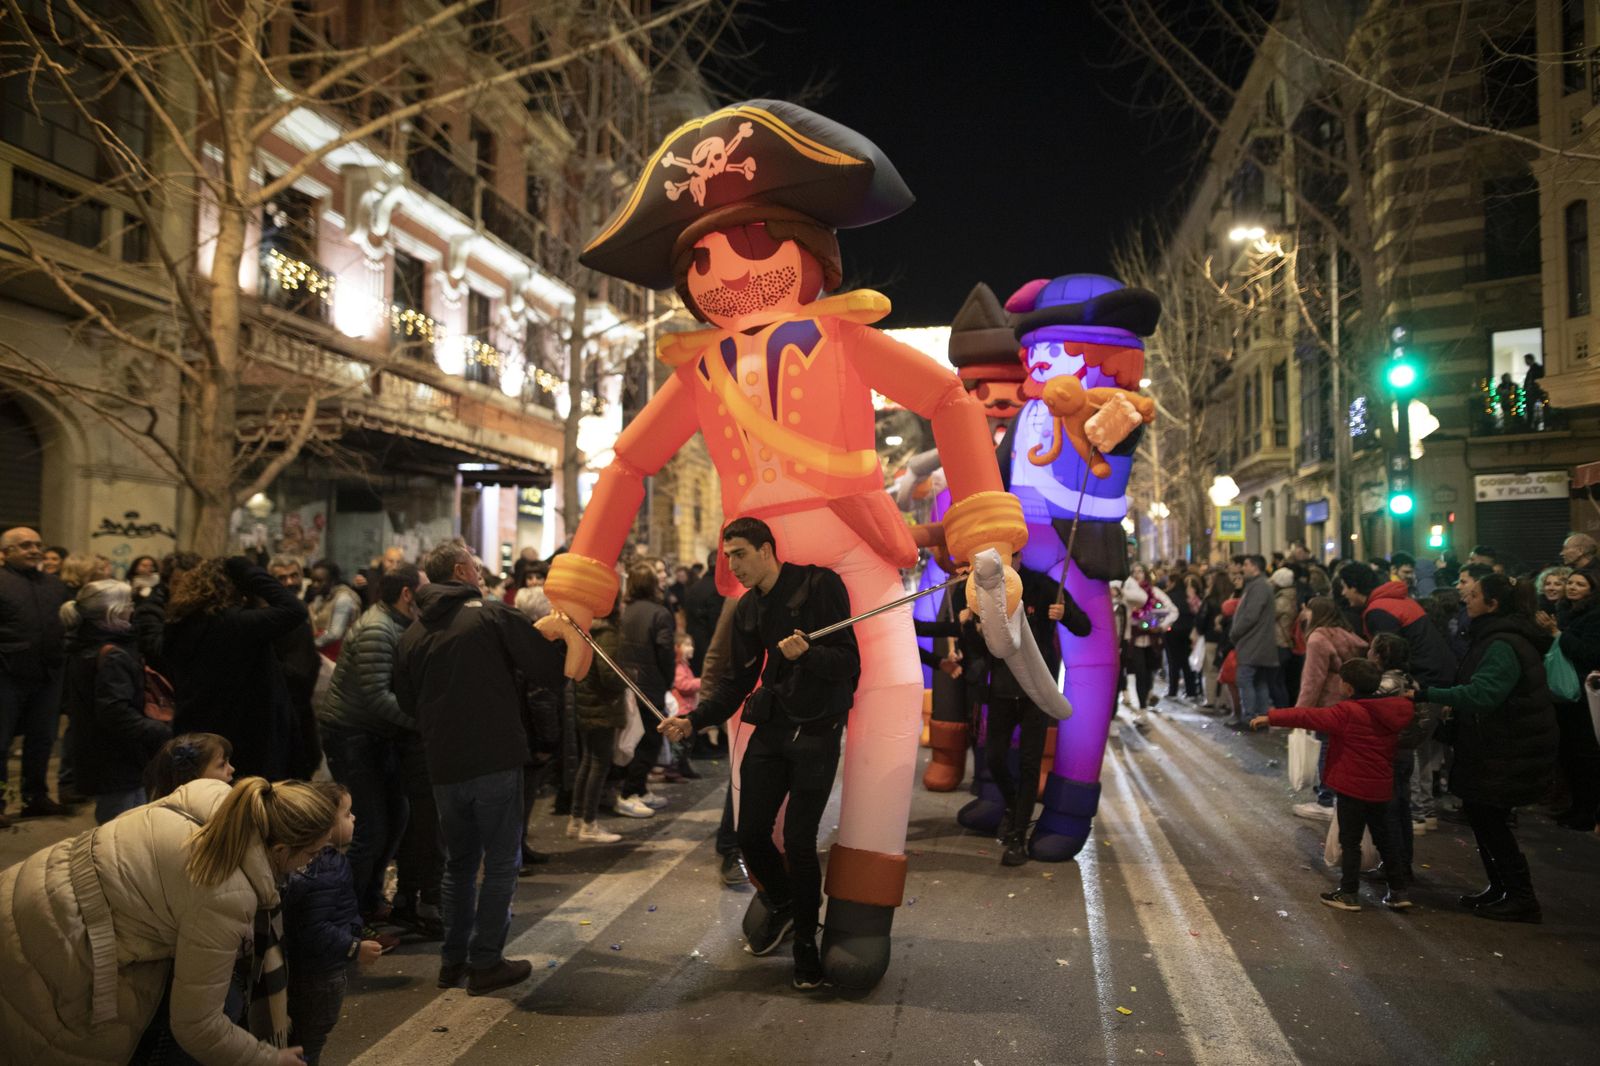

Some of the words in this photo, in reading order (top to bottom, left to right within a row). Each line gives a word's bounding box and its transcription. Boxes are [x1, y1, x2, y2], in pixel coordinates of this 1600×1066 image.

[1480, 477, 1532, 486] COMPRO
[1496, 488, 1504, 496] Y
[1508, 486, 1548, 495] PLATA
